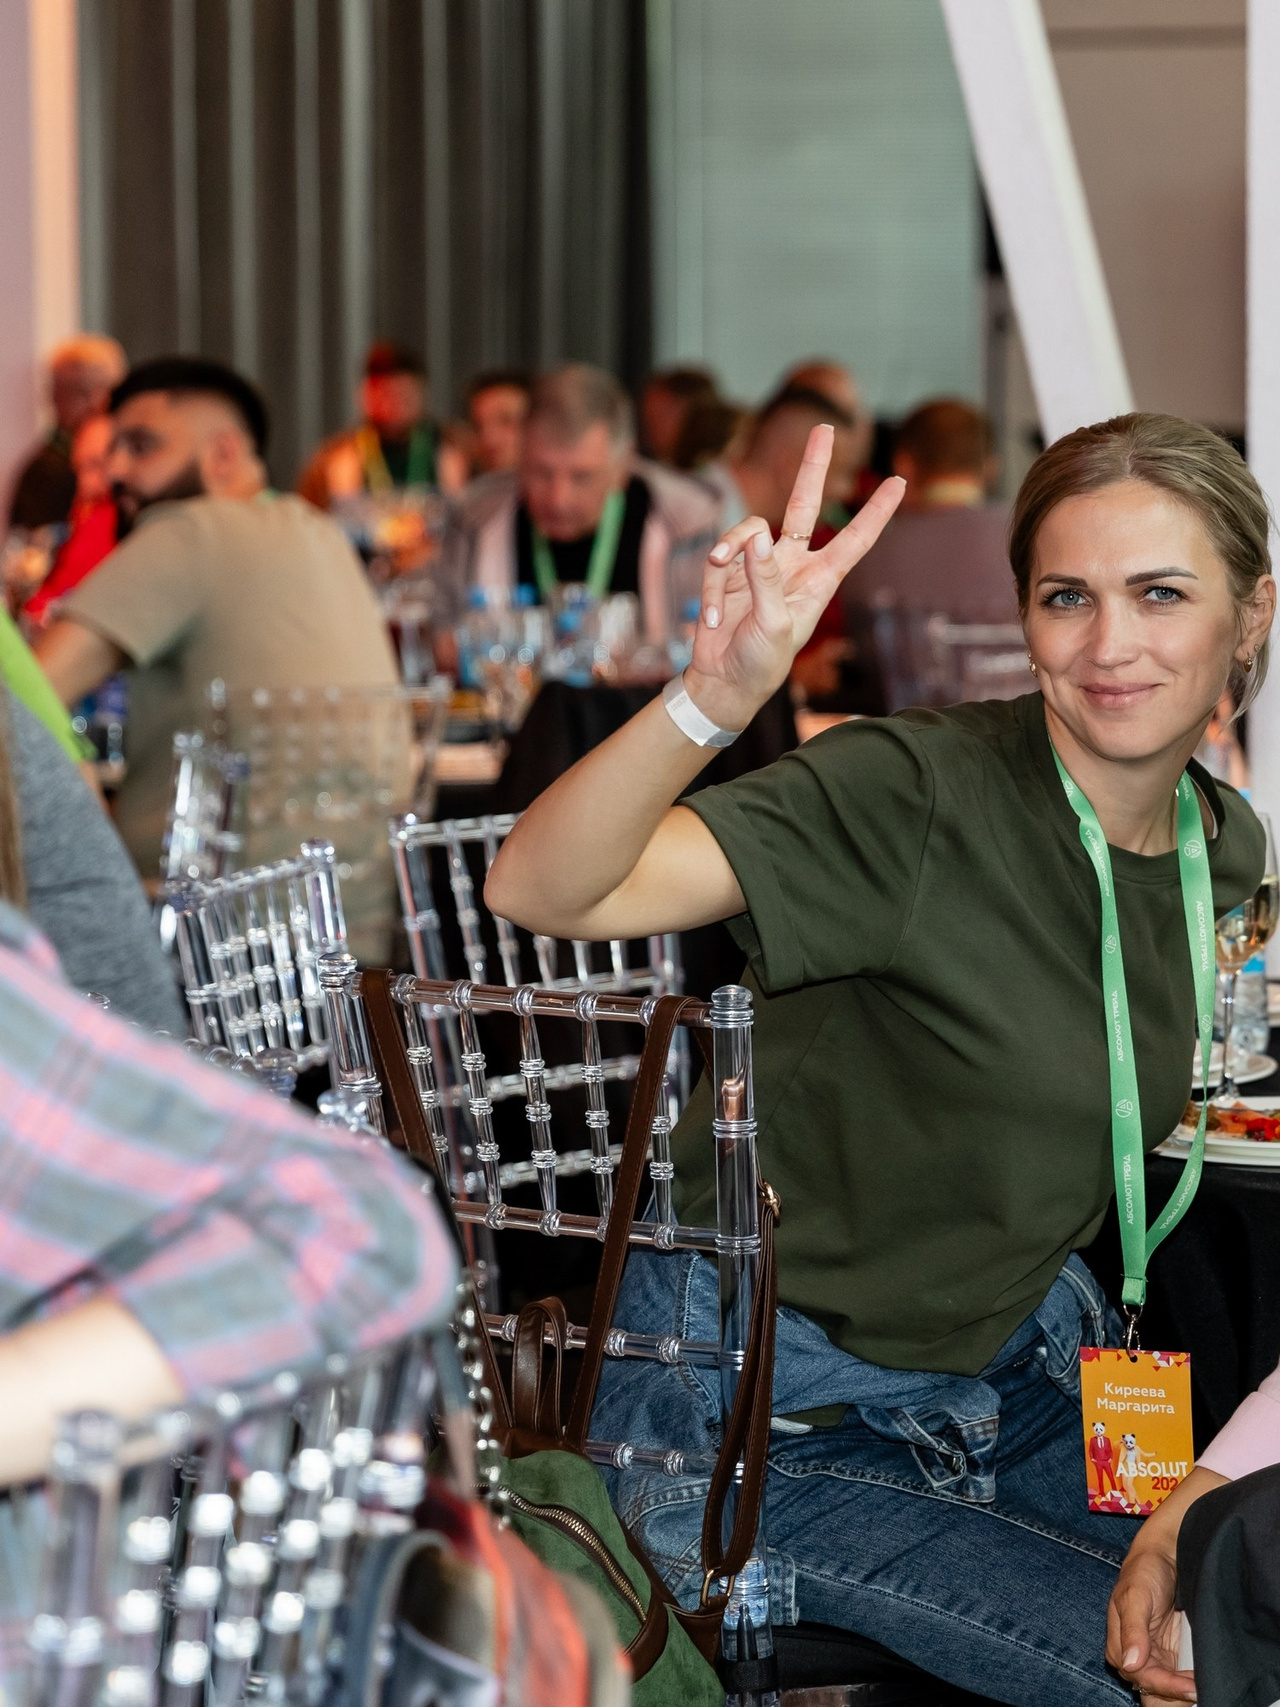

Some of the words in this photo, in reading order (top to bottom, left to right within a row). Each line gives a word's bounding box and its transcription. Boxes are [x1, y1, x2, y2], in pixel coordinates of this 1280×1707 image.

[1124, 1182, 1134, 1225] АБСОЛЮТ
[1104, 1382, 1166, 1399] Киреева
[1096, 1397, 1175, 1415] Маргарита
[1115, 1461, 1188, 1478] ABSOLUT
[1151, 1476, 1179, 1491] 202
